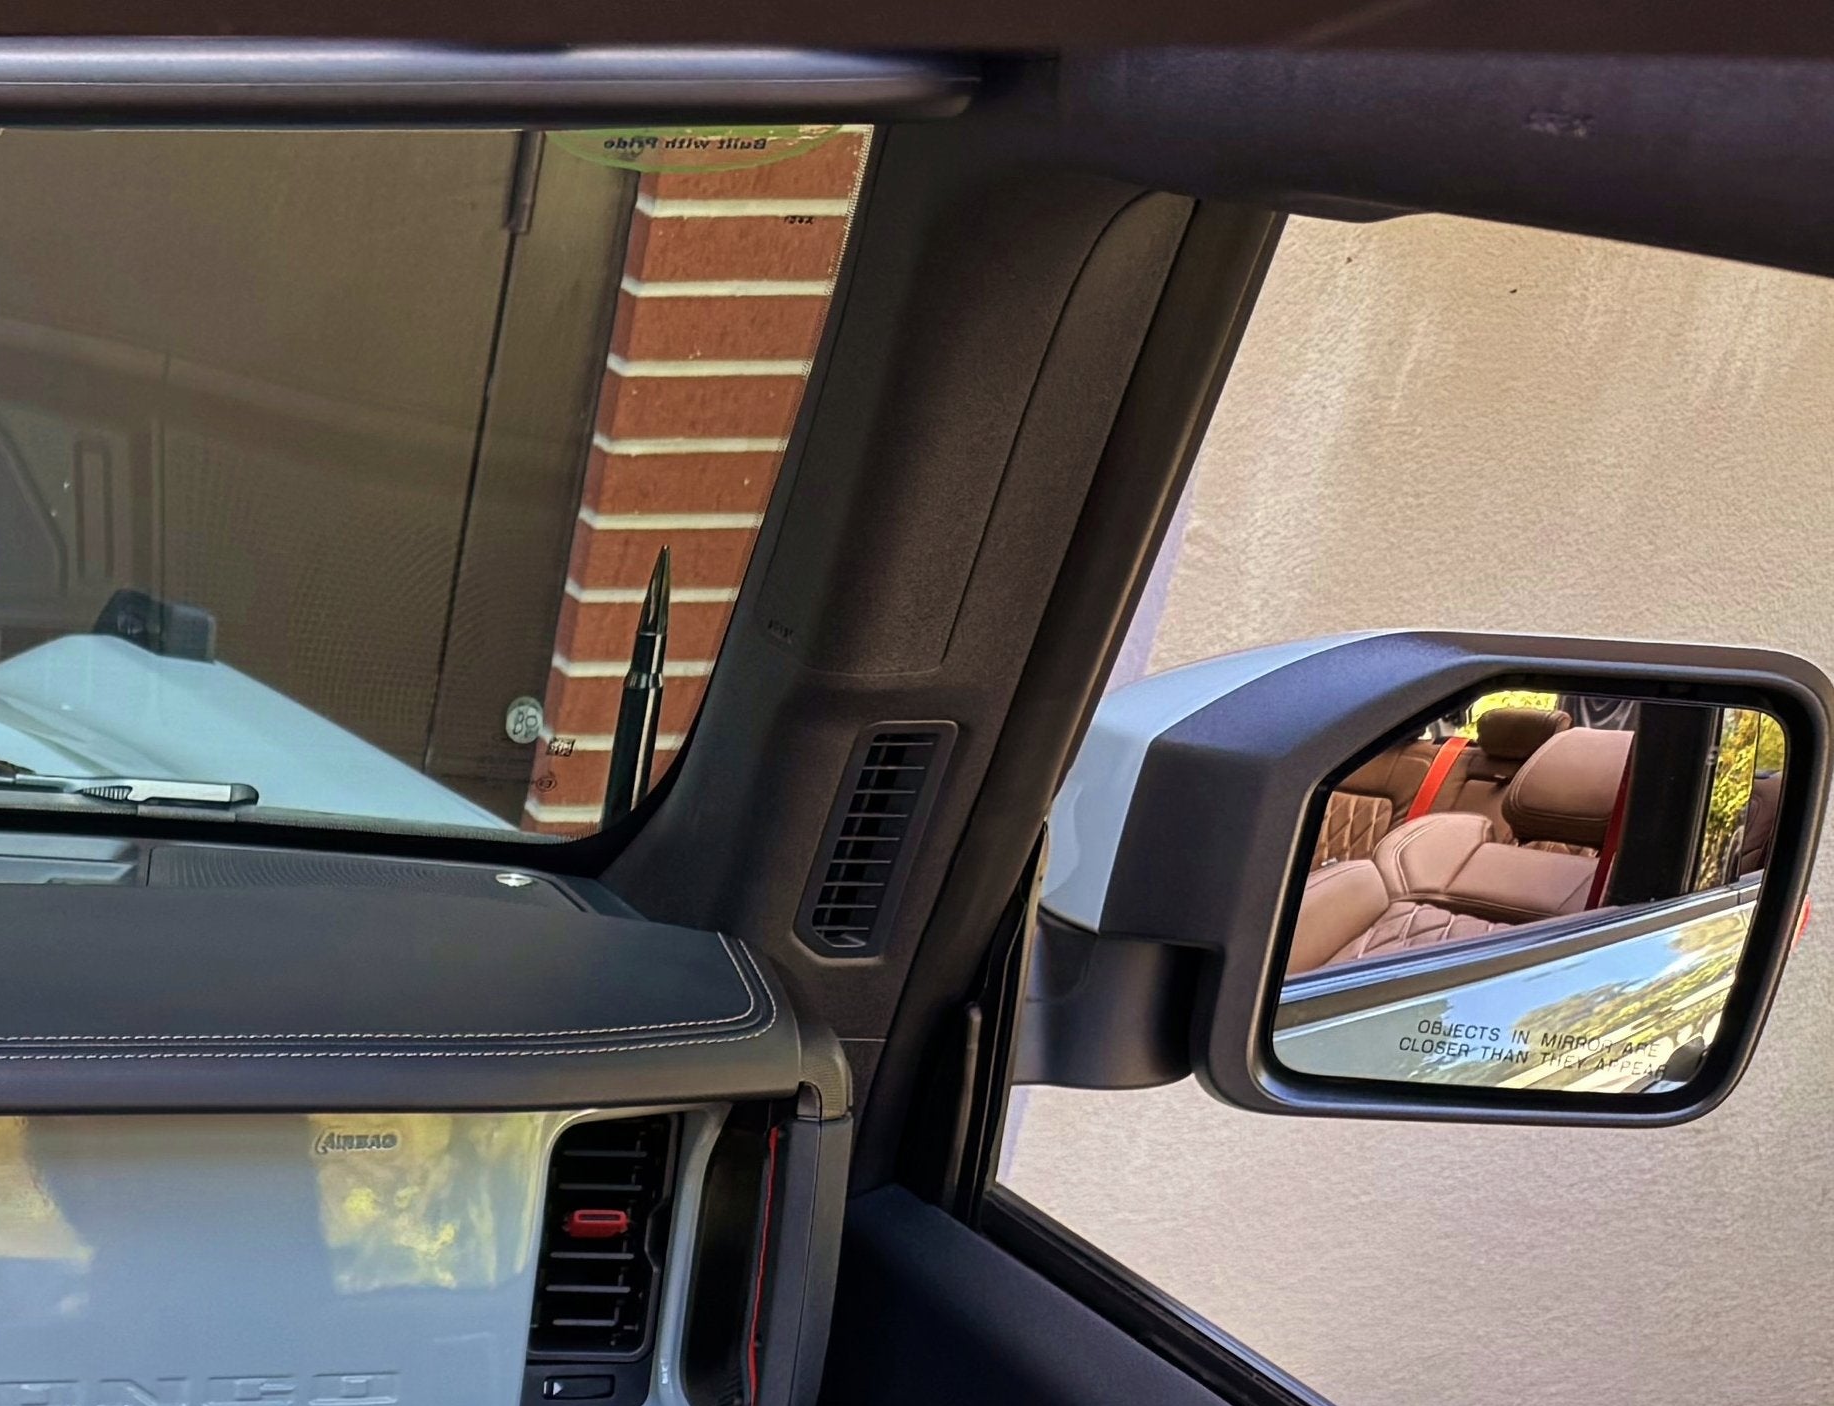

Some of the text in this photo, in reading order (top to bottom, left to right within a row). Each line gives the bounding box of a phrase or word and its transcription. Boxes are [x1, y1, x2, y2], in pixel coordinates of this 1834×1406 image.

[1399, 1037, 1668, 1077] CLOSER THAN THEY APPEAR
[1418, 1020, 1660, 1058] OBJECTS IN MIRROR ARE
